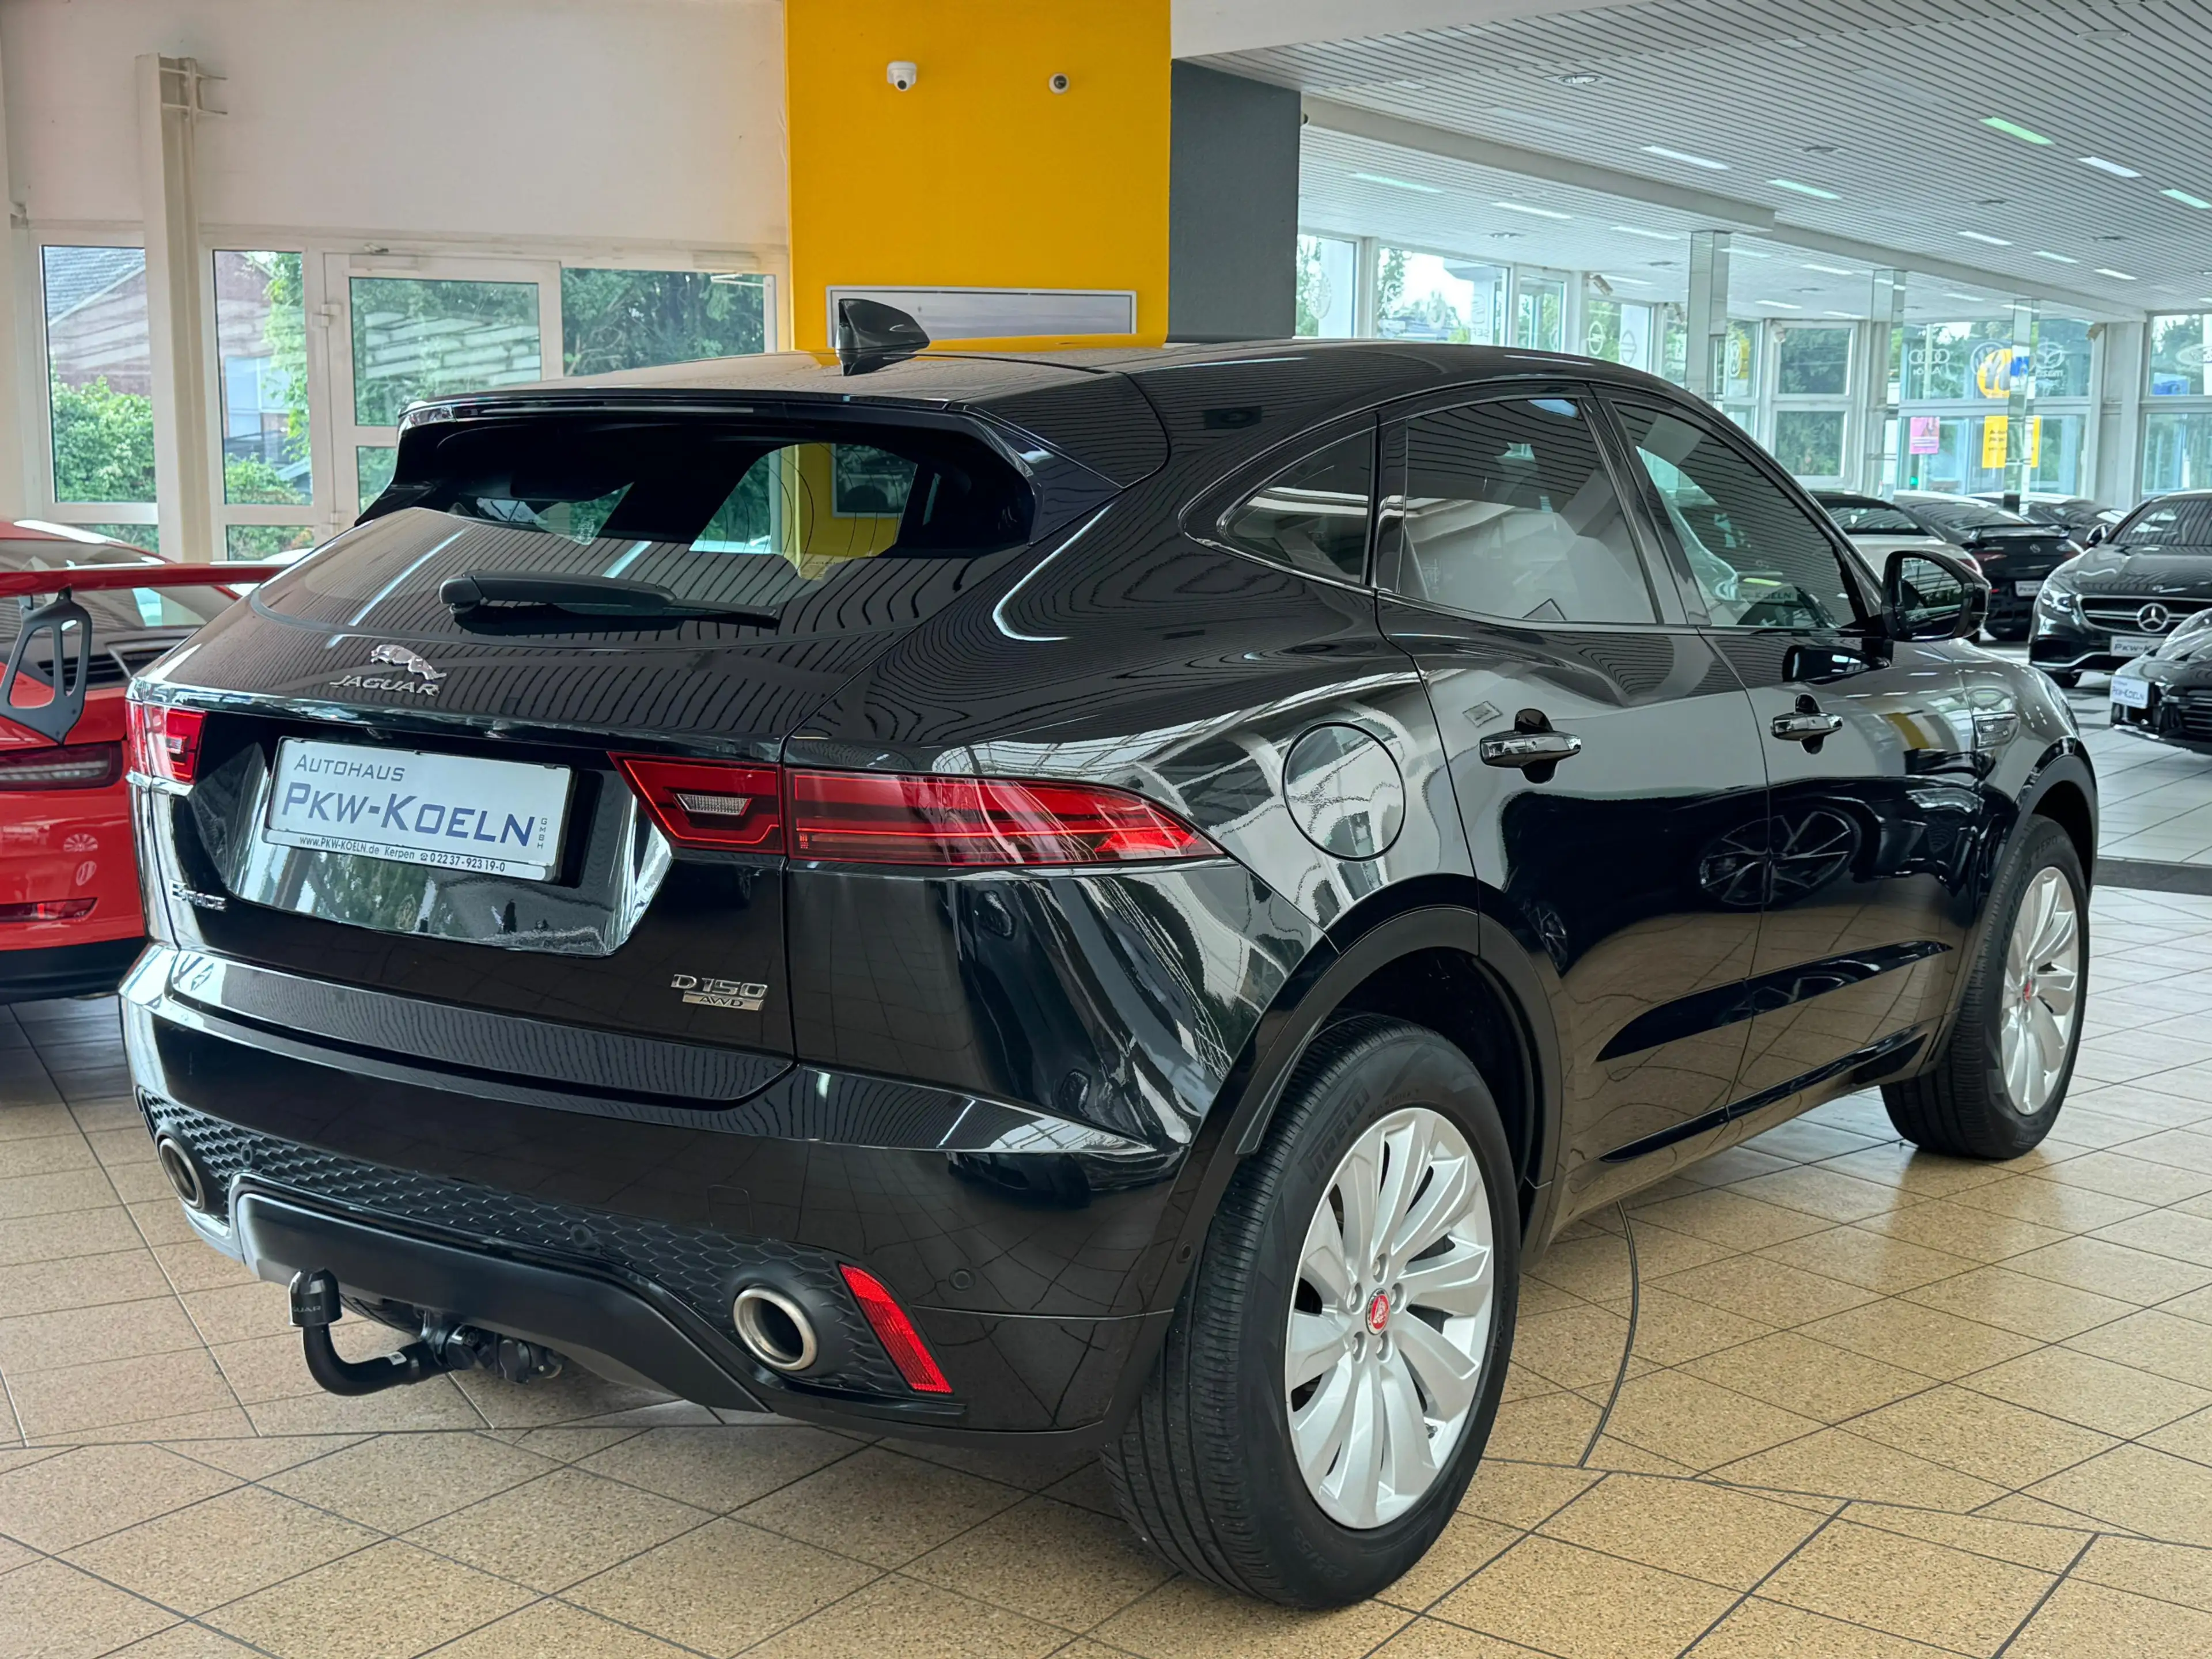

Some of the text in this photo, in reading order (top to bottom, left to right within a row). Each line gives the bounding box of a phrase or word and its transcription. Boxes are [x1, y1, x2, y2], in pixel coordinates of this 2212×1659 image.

[2114, 643, 2153, 652] PKW-K
[329, 675, 440, 696] JAGUAR
[294, 754, 406, 782] AUTOHAUS
[281, 782, 535, 847] PKW-KOELN
[300, 836, 380, 855] www.PKW-KOELN.de
[384, 846, 415, 860] Kerpen
[699, 995, 744, 1007] AWD
[1297, 1077, 1371, 1184] PIRELLI
